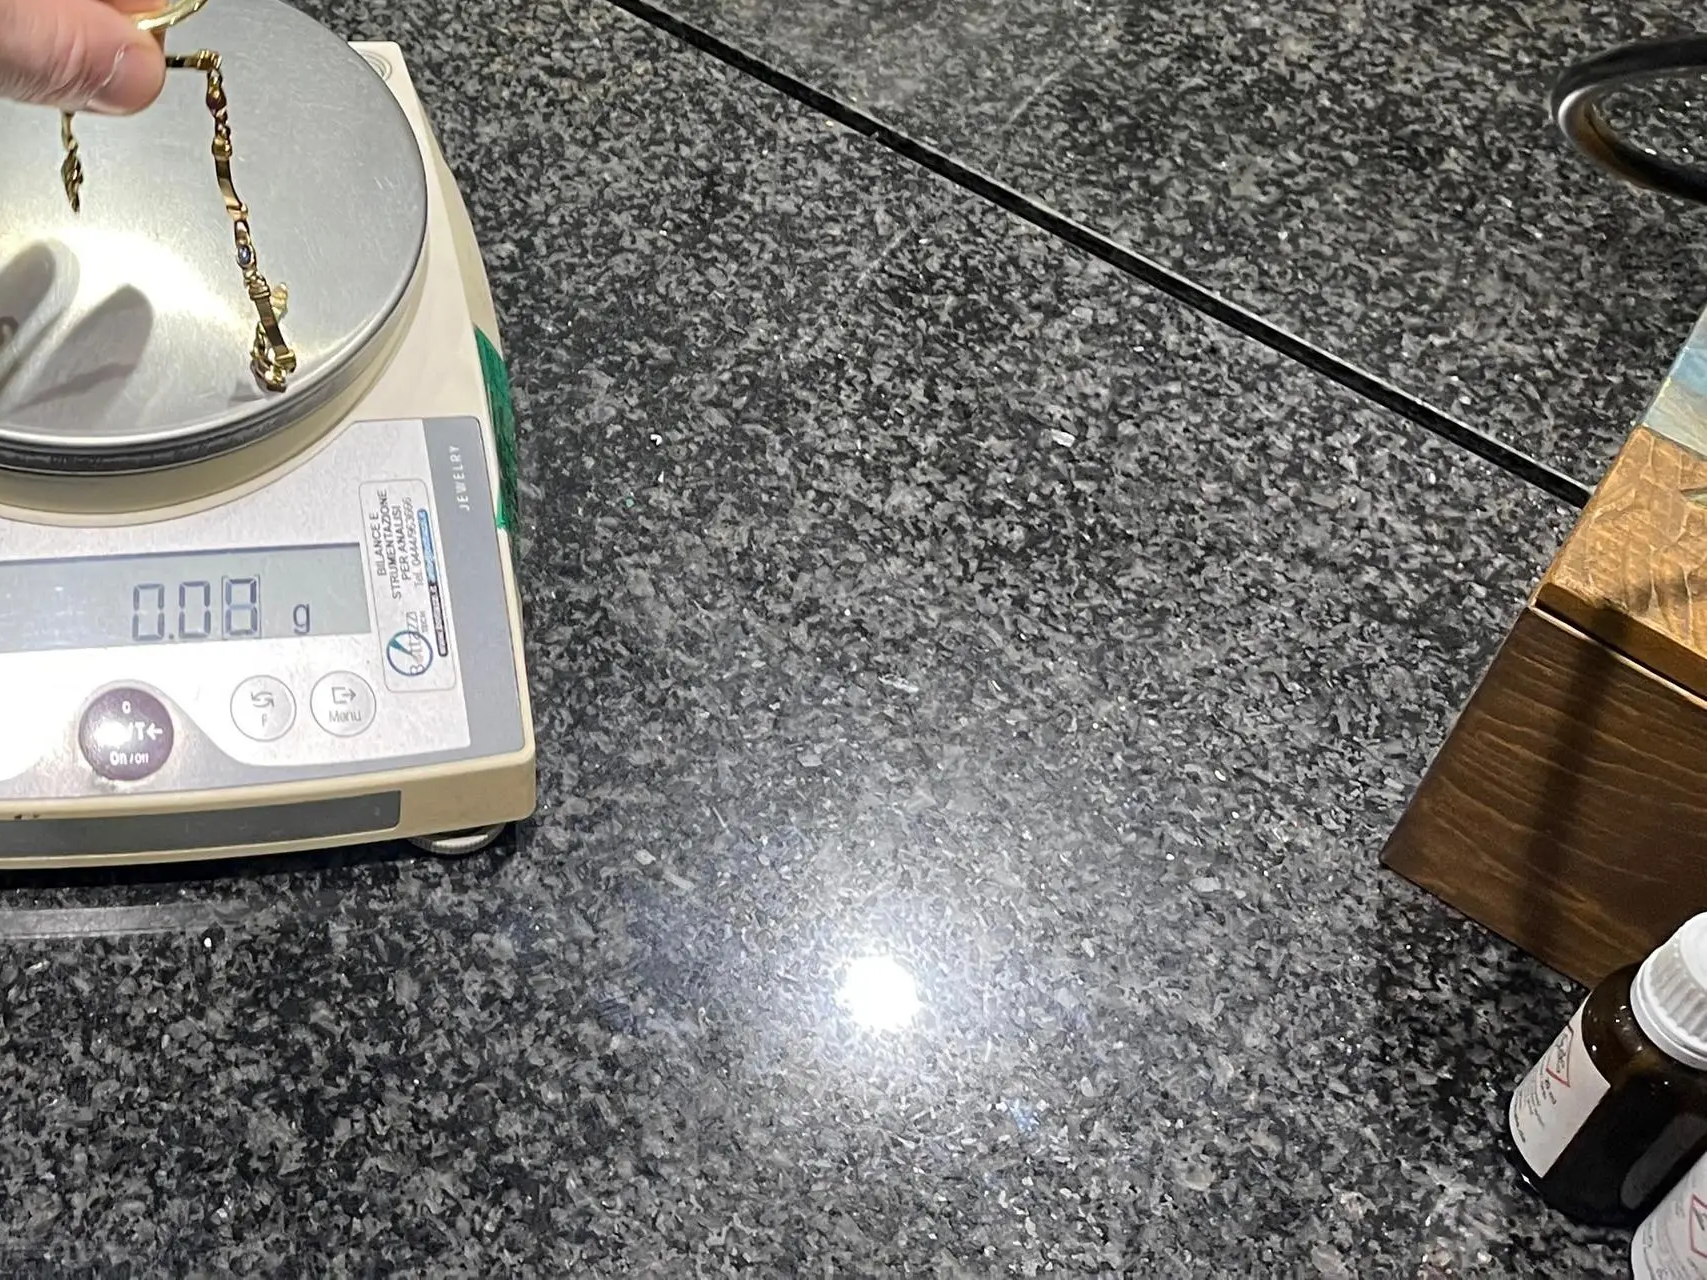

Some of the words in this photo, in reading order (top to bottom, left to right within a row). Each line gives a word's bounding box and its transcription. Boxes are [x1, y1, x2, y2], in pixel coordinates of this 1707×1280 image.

[449, 445, 470, 512] JEWELRY
[372, 521, 387, 576] BILANCE
[377, 488, 402, 600] STRUMENTAZIONE
[392, 505, 407, 552] ANALISI
[398, 553, 411, 581] PER
[132, 577, 259, 642] 0.08
[293, 603, 311, 635] g
[328, 710, 362, 723] Menu
